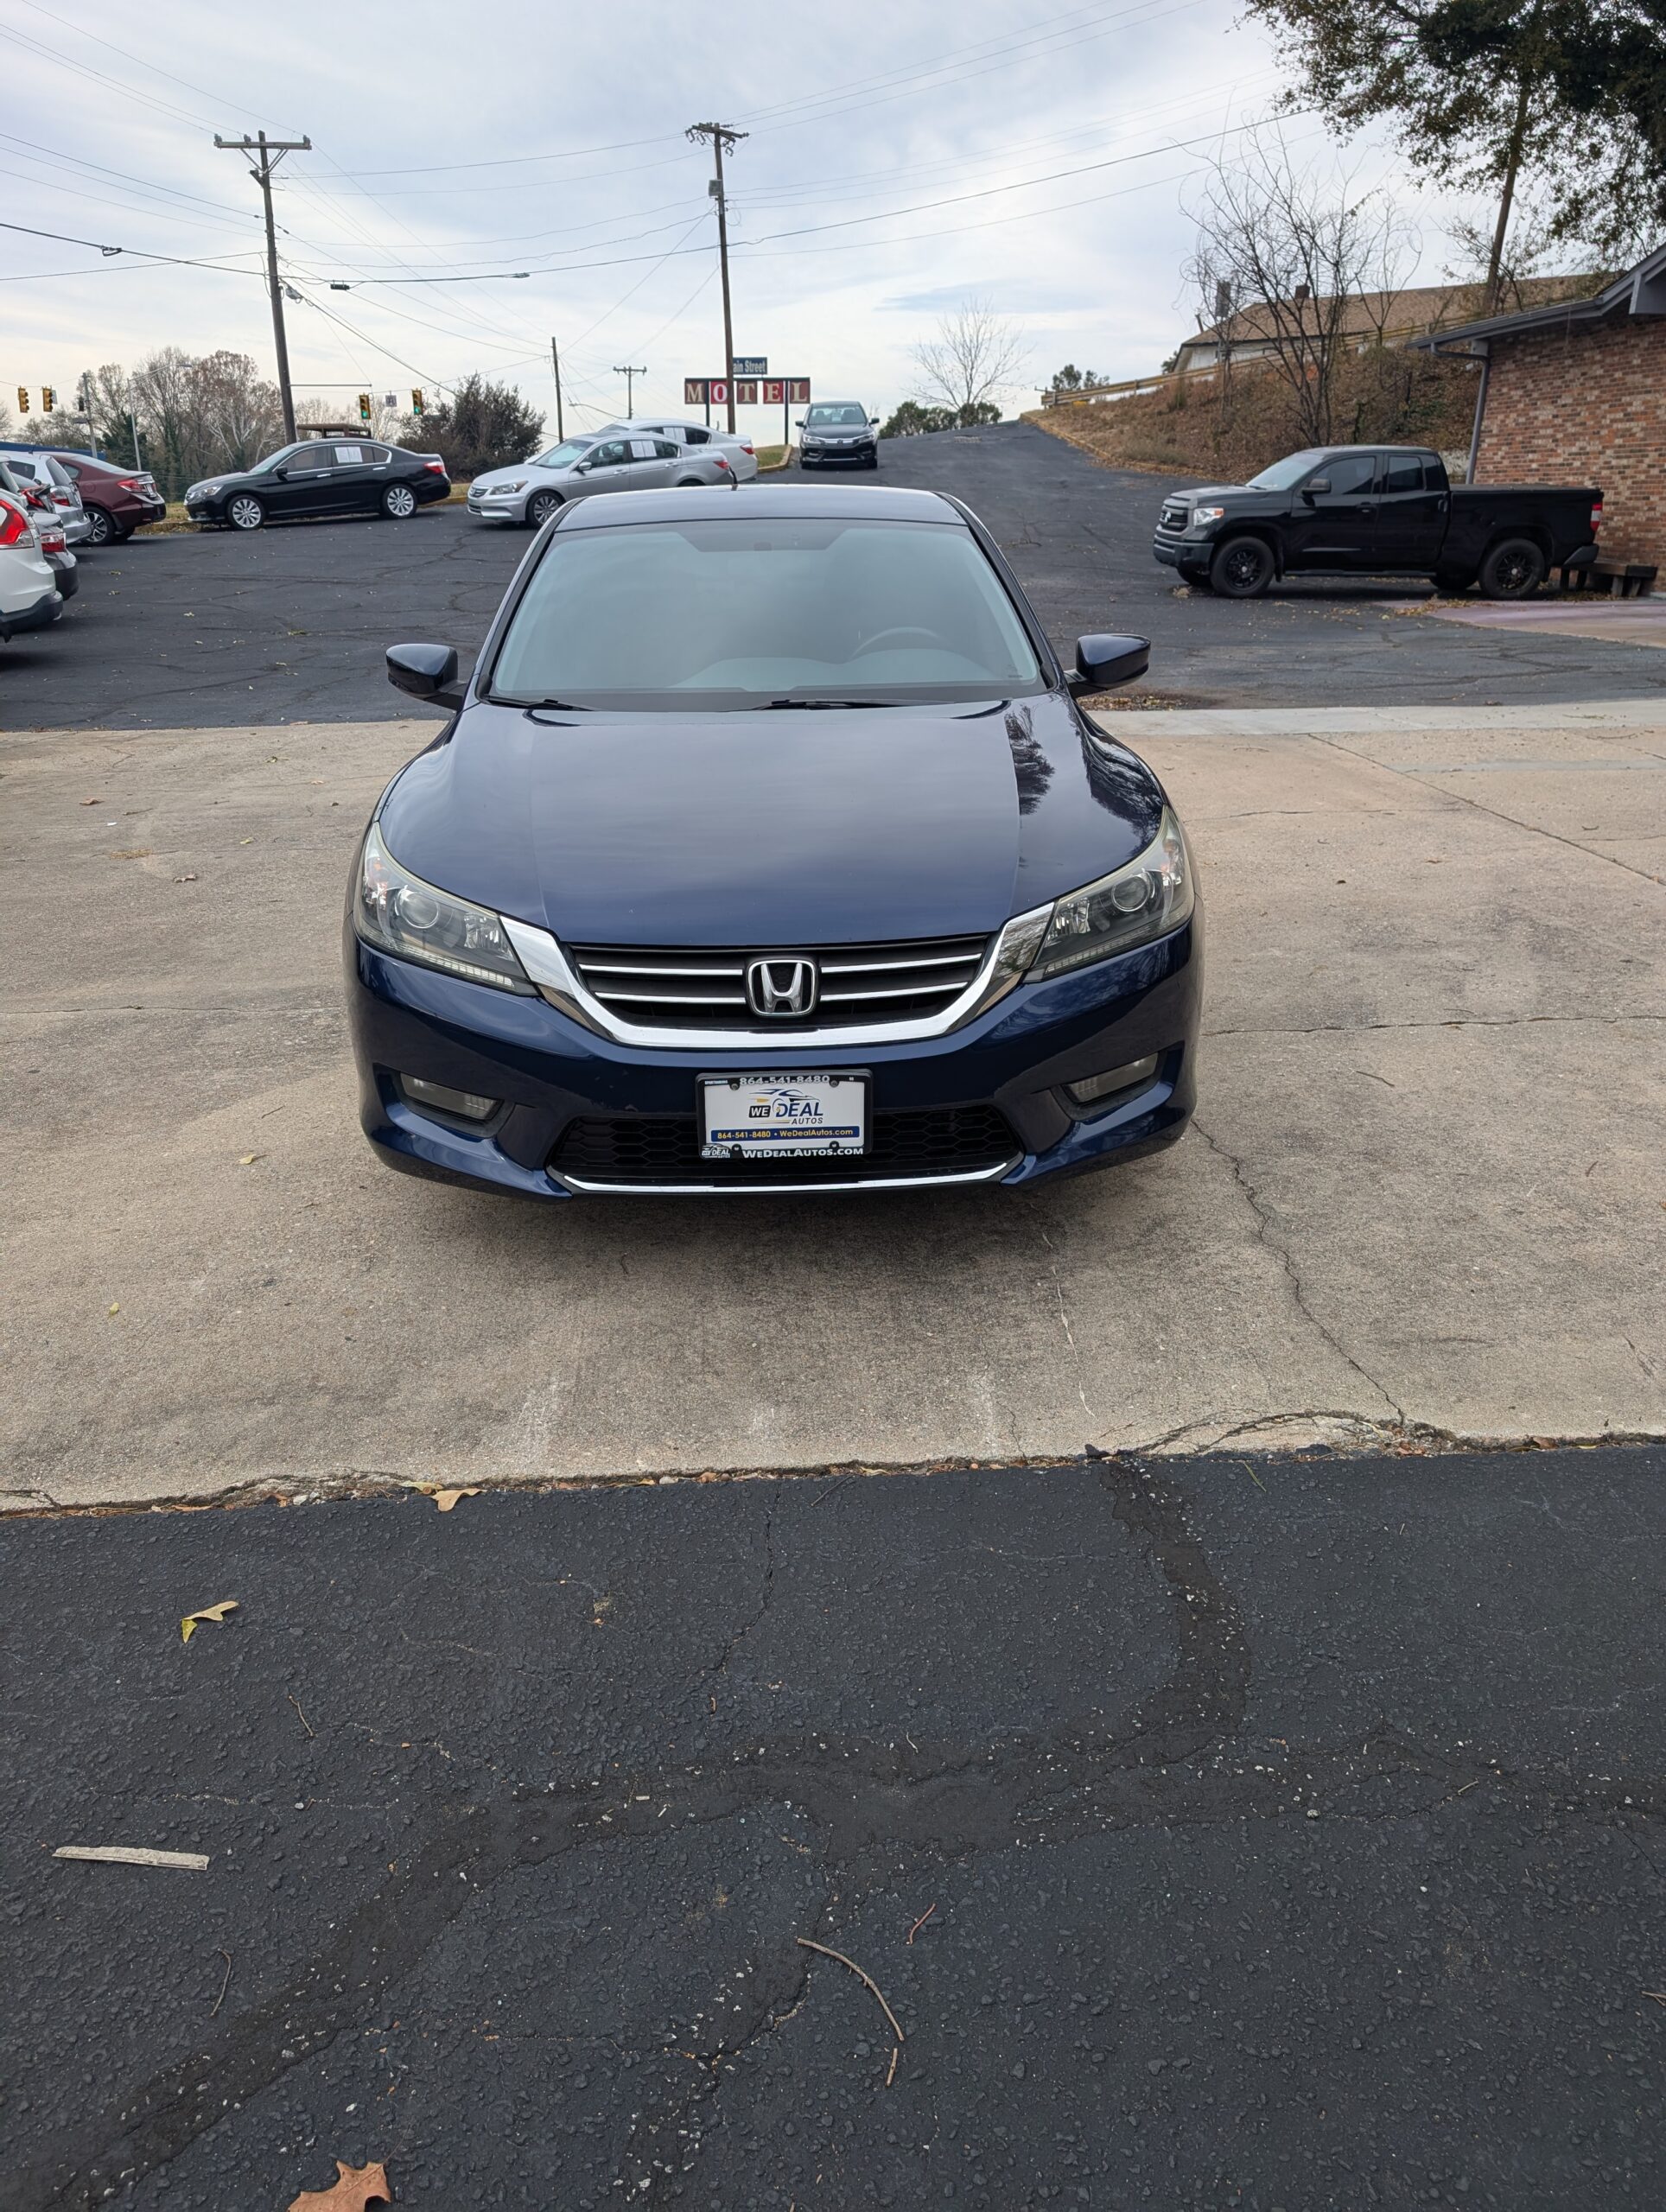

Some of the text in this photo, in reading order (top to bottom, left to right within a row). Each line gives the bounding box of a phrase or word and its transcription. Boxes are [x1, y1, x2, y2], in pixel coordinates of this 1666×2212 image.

[733, 359, 766, 373] ain Street
[687, 382, 807, 402] MOTEL
[739, 1075, 830, 1085] 864-541-8480
[751, 1103, 823, 1118] WE DEAL
[717, 1128, 853, 1140] 864-541-8480 WeDealAutos.com
